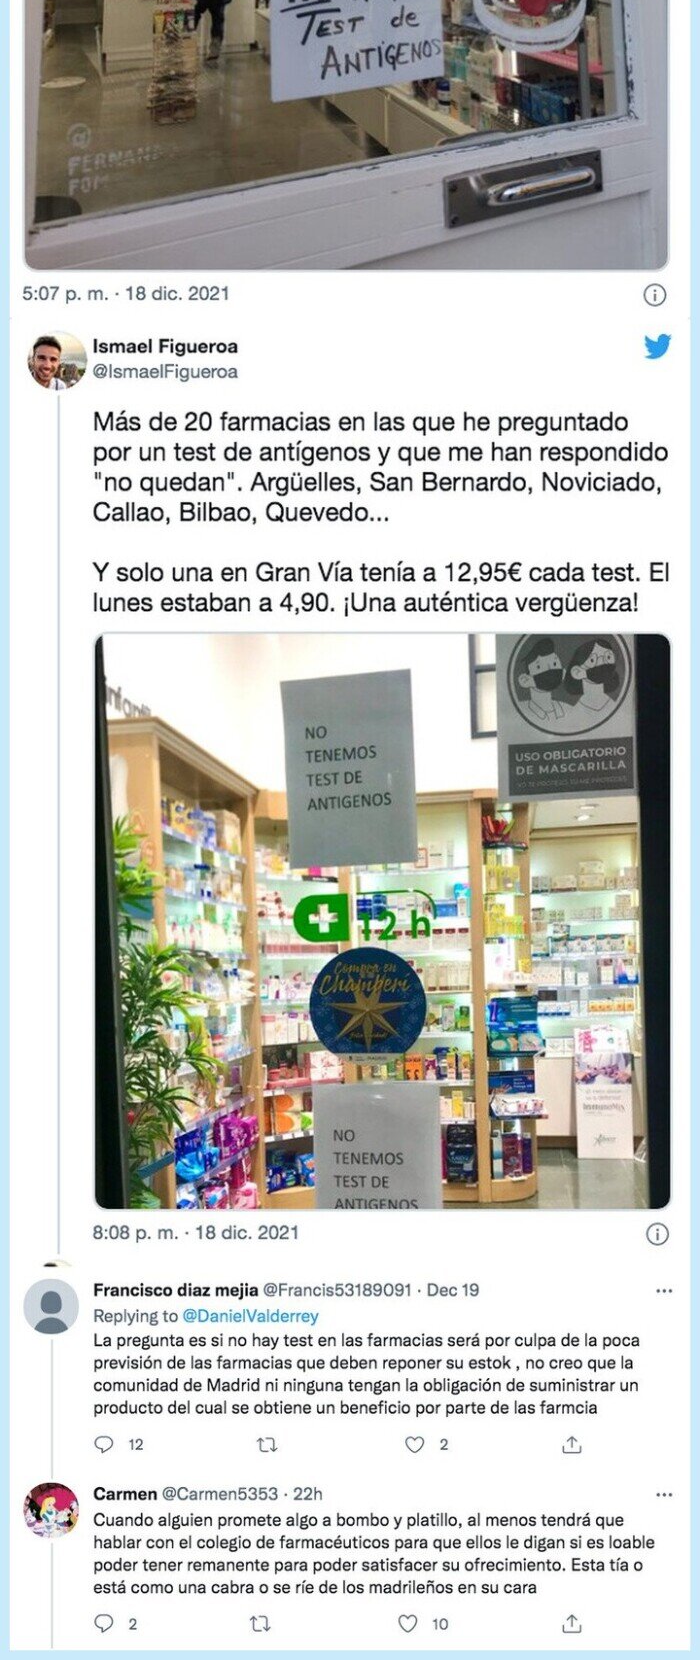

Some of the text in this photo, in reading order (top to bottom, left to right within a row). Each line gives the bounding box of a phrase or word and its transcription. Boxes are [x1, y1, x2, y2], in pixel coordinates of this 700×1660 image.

[390, 5, 420, 28] de
[23, 286, 228, 304] 5:07 p. m. 18 dic. 2021
[93, 338, 238, 357] Ismael Figueroa
[93, 364, 238, 382] @IsmaelFigueroa
[94, 410, 628, 436] Más de 20 farmacias en las que he preguntado
[93, 501, 388, 525] Callao, Bilbao, Quevedo...
[305, 725, 327, 740] NO
[306, 745, 377, 764] TENEMOS
[515, 746, 627, 763] USO OBLIGATORIO
[516, 760, 627, 776] DE MASCARILLA
[307, 771, 363, 787] TEST DE
[308, 792, 393, 811] ANTIGENOS
[360, 910, 397, 941] 12
[333, 1129, 355, 1142] NO
[333, 1152, 404, 1166] TENEMOS
[334, 1175, 389, 1189] TEST DE
[334, 1197, 419, 1210] ANTIGENOS
[94, 1283, 479, 1300] Francisco diaz mejia @Francis53189091 Dec 19
[94, 1308, 319, 1326] Replying to @DanielValderrey
[129, 1439, 143, 1450] 12
[93, 1487, 322, 1501] Carmen @Carmen5353 22h
[94, 1580, 536, 1594] está como una cabra o se ríe de los madrileños en su cara
[433, 1618, 448, 1630] 10
